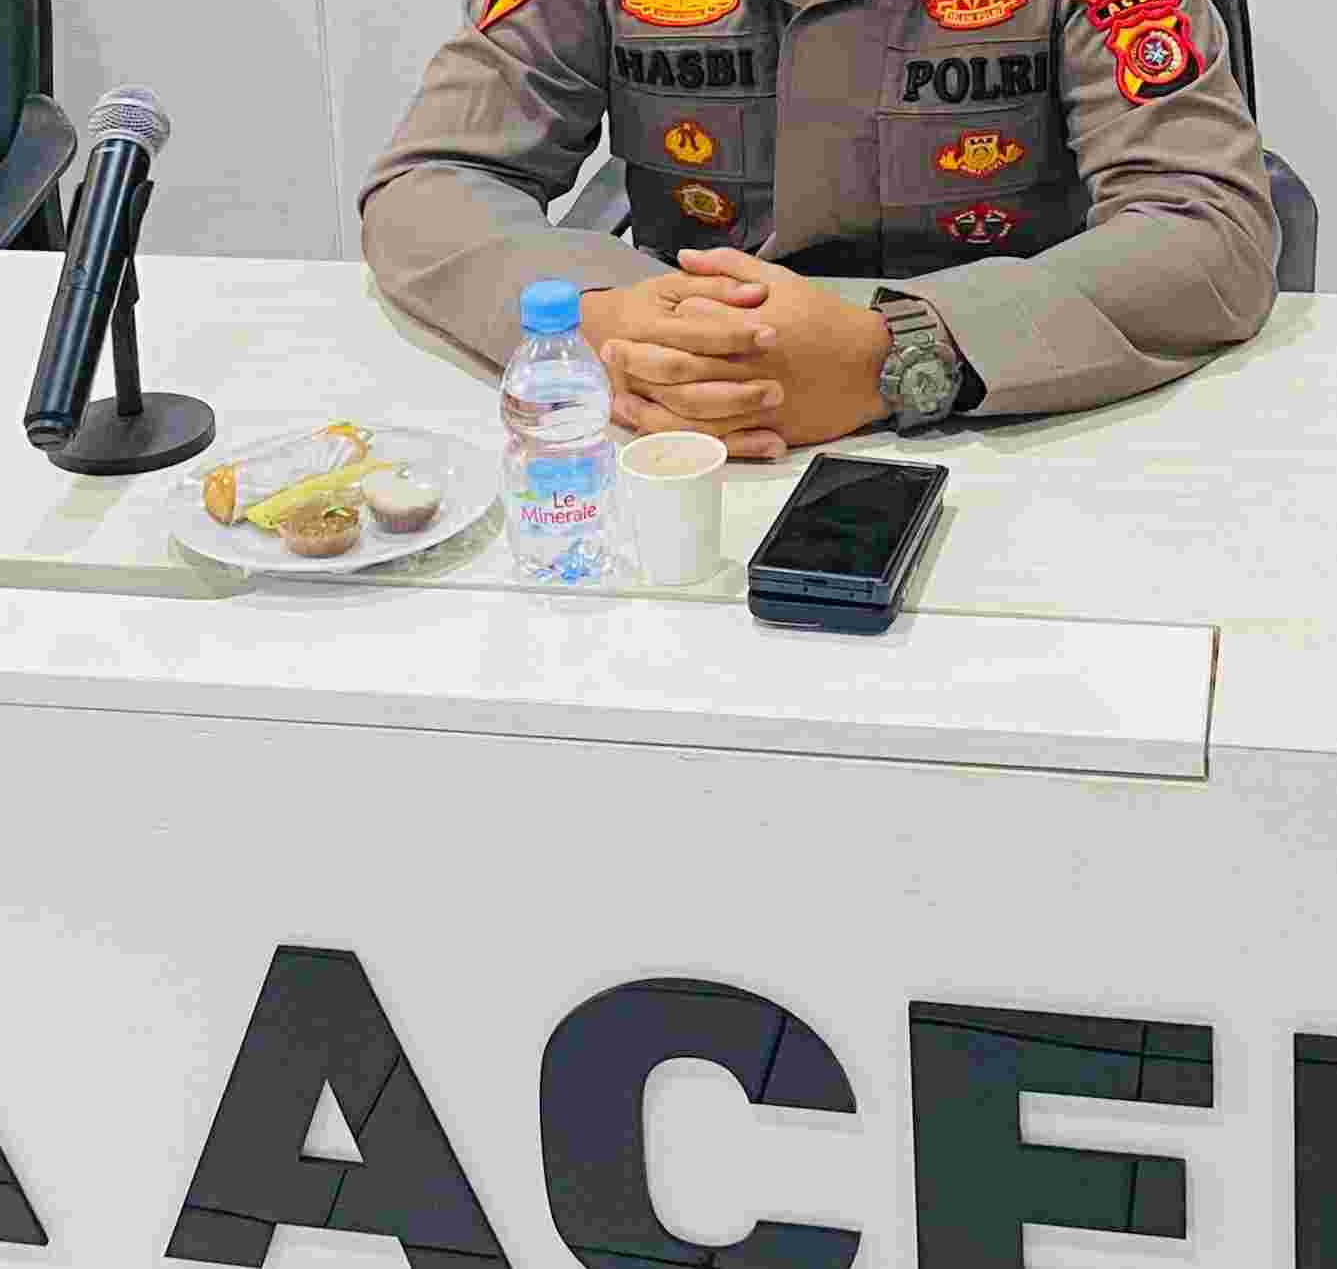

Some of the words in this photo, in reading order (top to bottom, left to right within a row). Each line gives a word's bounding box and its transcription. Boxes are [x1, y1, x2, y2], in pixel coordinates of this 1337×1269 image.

[613, 45, 756, 89] HASBI
[902, 51, 1050, 104] POLRI
[520, 502, 598, 524] Minerale
[552, 491, 577, 508] Le
